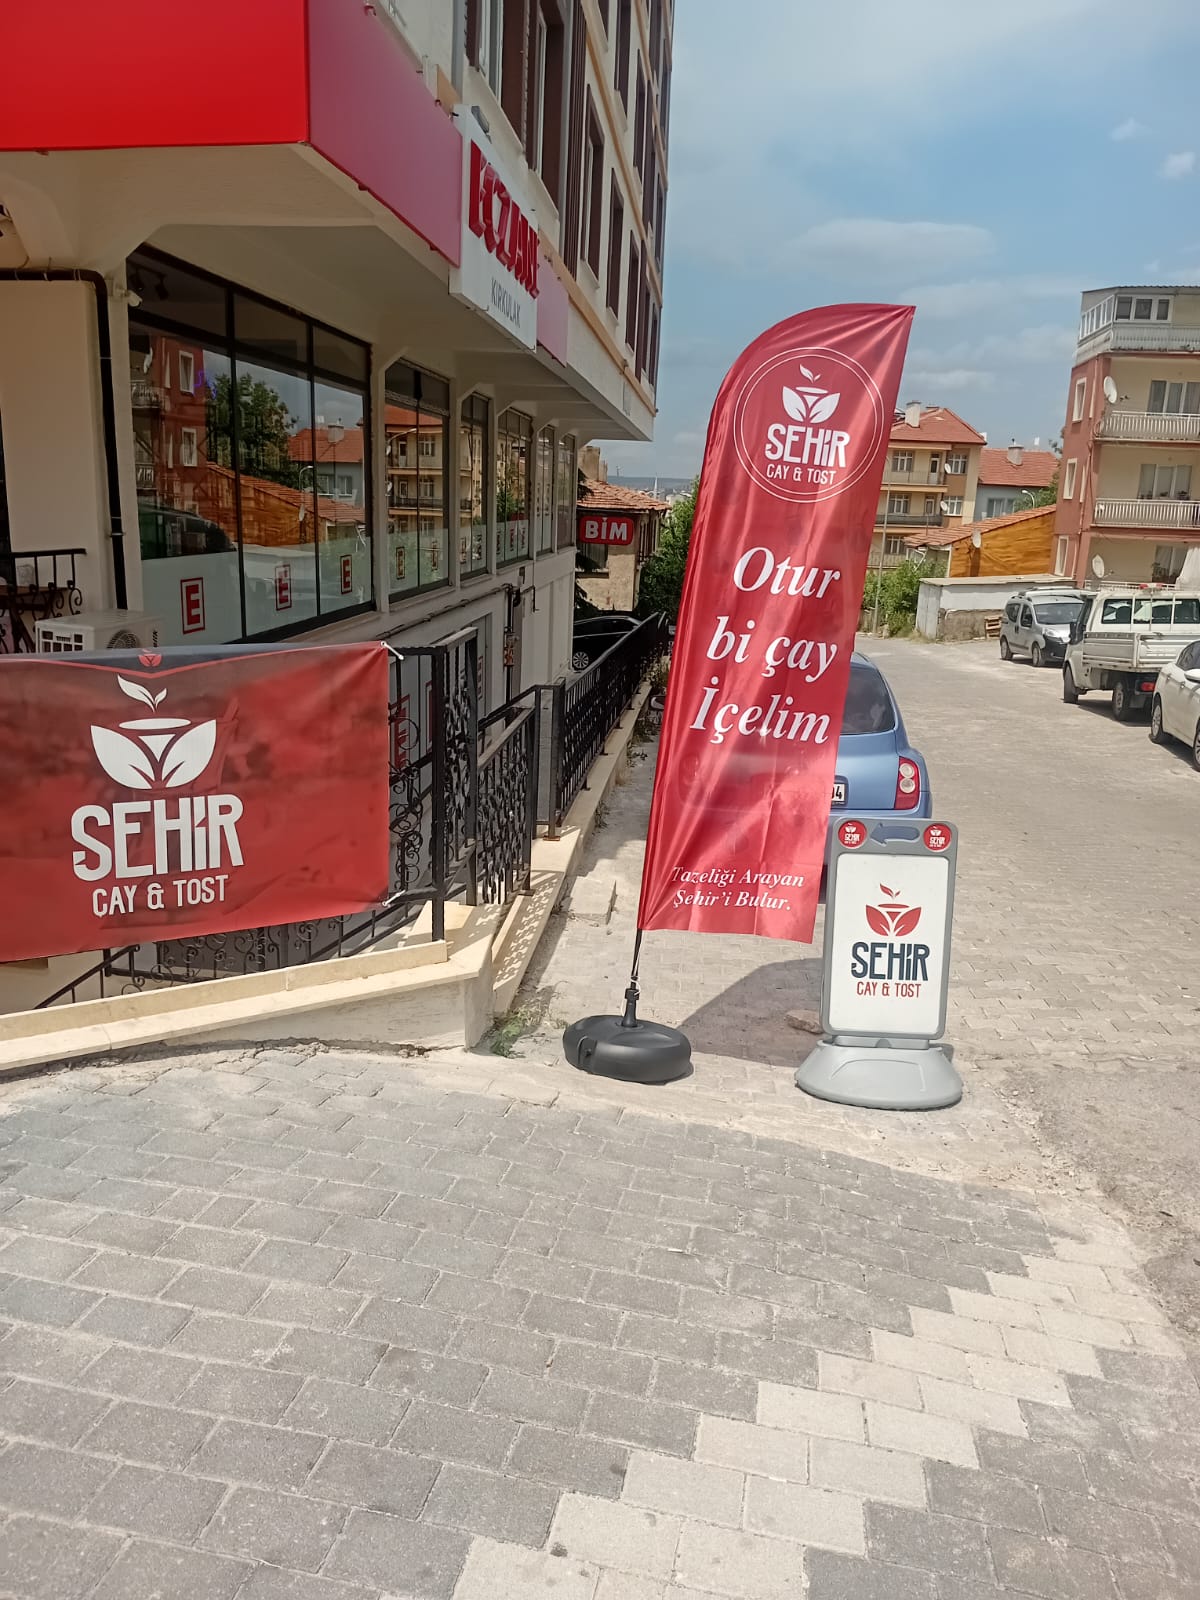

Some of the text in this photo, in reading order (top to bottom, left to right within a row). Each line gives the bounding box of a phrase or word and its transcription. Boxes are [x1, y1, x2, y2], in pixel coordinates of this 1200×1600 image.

[793, 467, 802, 482] &
[807, 468, 836, 485] TOST
[585, 517, 627, 541] BİM
[734, 547, 841, 599] Otur
[185, 584, 201, 626] E
[706, 615, 838, 683] bi çay
[689, 676, 831, 745] İçelim
[671, 866, 805, 888] Tazeliği Arayan
[147, 883, 164, 910] &
[173, 875, 228, 907] TOST
[734, 891, 791, 911] Bulur.
[881, 982, 890, 997] &
[895, 983, 921, 998] TOST
